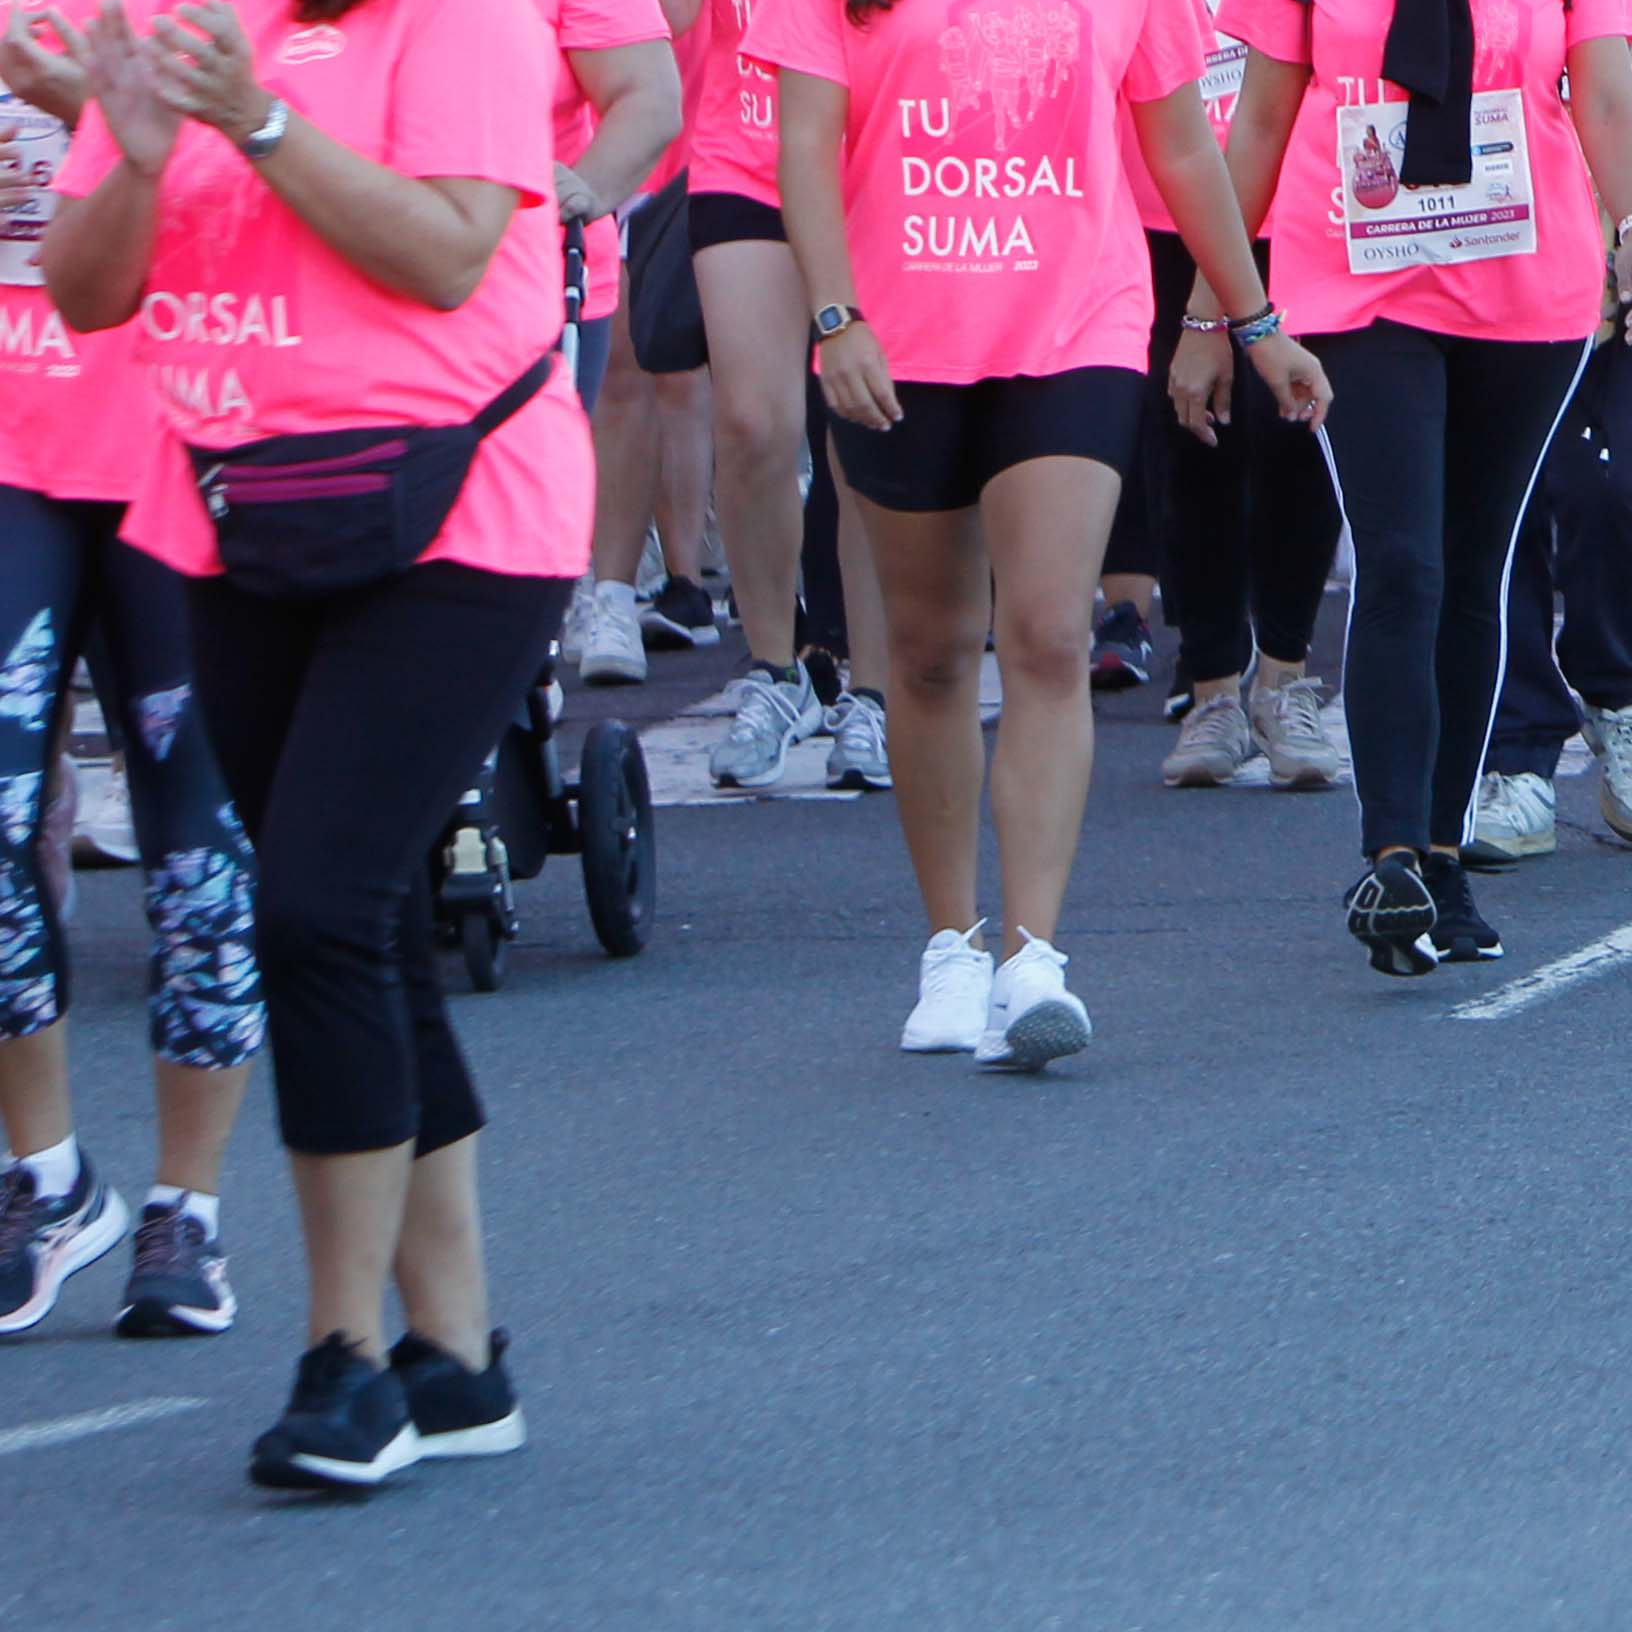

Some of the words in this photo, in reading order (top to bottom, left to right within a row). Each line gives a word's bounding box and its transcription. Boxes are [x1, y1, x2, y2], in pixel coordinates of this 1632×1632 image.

[740, 90, 773, 129] SU
[899, 97, 950, 139] TU
[901, 154, 1083, 199] DORSAL
[1418, 195, 1457, 213] 1011
[902, 215, 1035, 257] SUMA
[1366, 222, 1416, 236] CARRERA
[1417, 218, 1433, 231] DE
[1434, 216, 1451, 229] LA
[1453, 212, 1488, 226] MUJER
[1463, 230, 1521, 248] Santander
[1363, 242, 1420, 261] OYSHO
[141, 290, 303, 347] ORSAL
